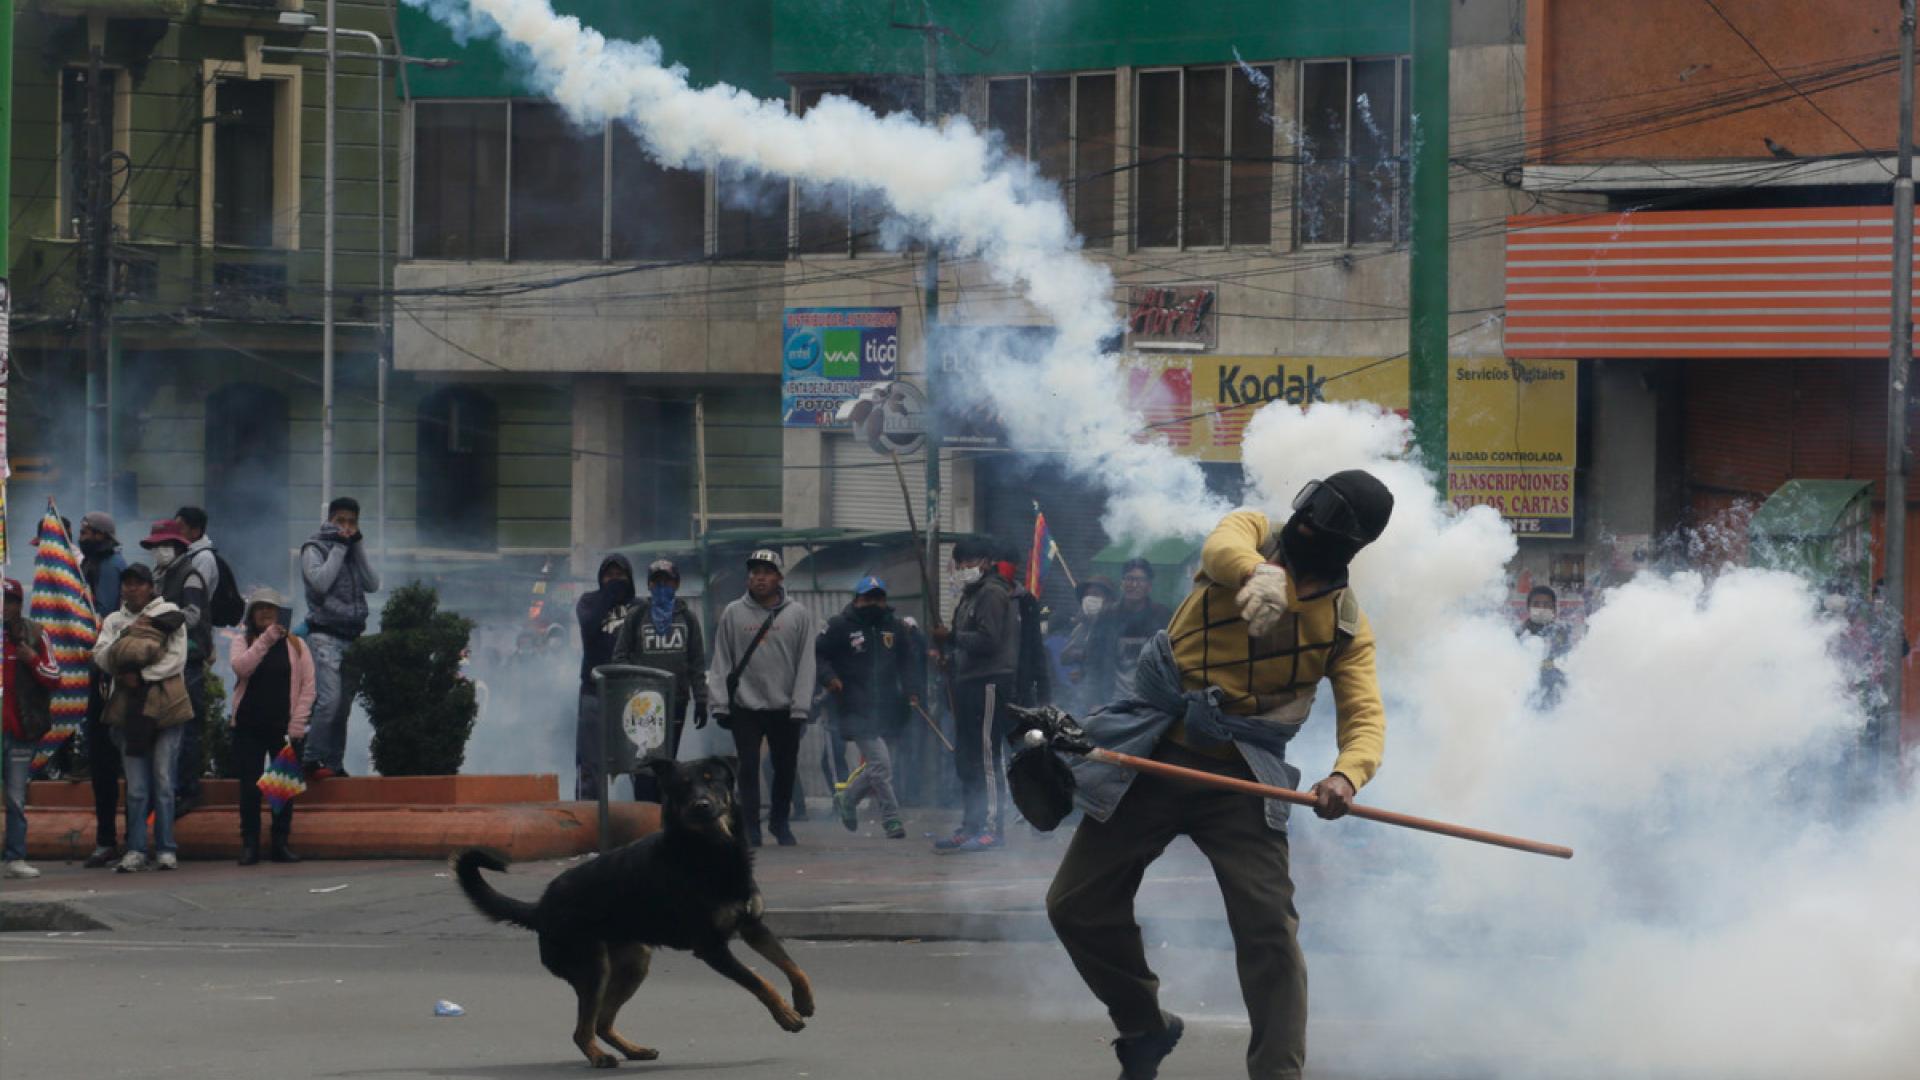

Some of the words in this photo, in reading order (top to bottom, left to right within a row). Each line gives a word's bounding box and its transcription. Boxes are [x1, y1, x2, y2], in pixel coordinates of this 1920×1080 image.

[865, 335, 897, 364] tigo
[1456, 367, 1509, 381] Servicios
[1218, 365, 1327, 404] Kodak
[1449, 452, 1489, 462] ALIDAD
[1491, 452, 1563, 462] CONTROLADA
[1450, 473, 1569, 491] RANSCRIPCIONES
[1511, 496, 1569, 513] CARTAS
